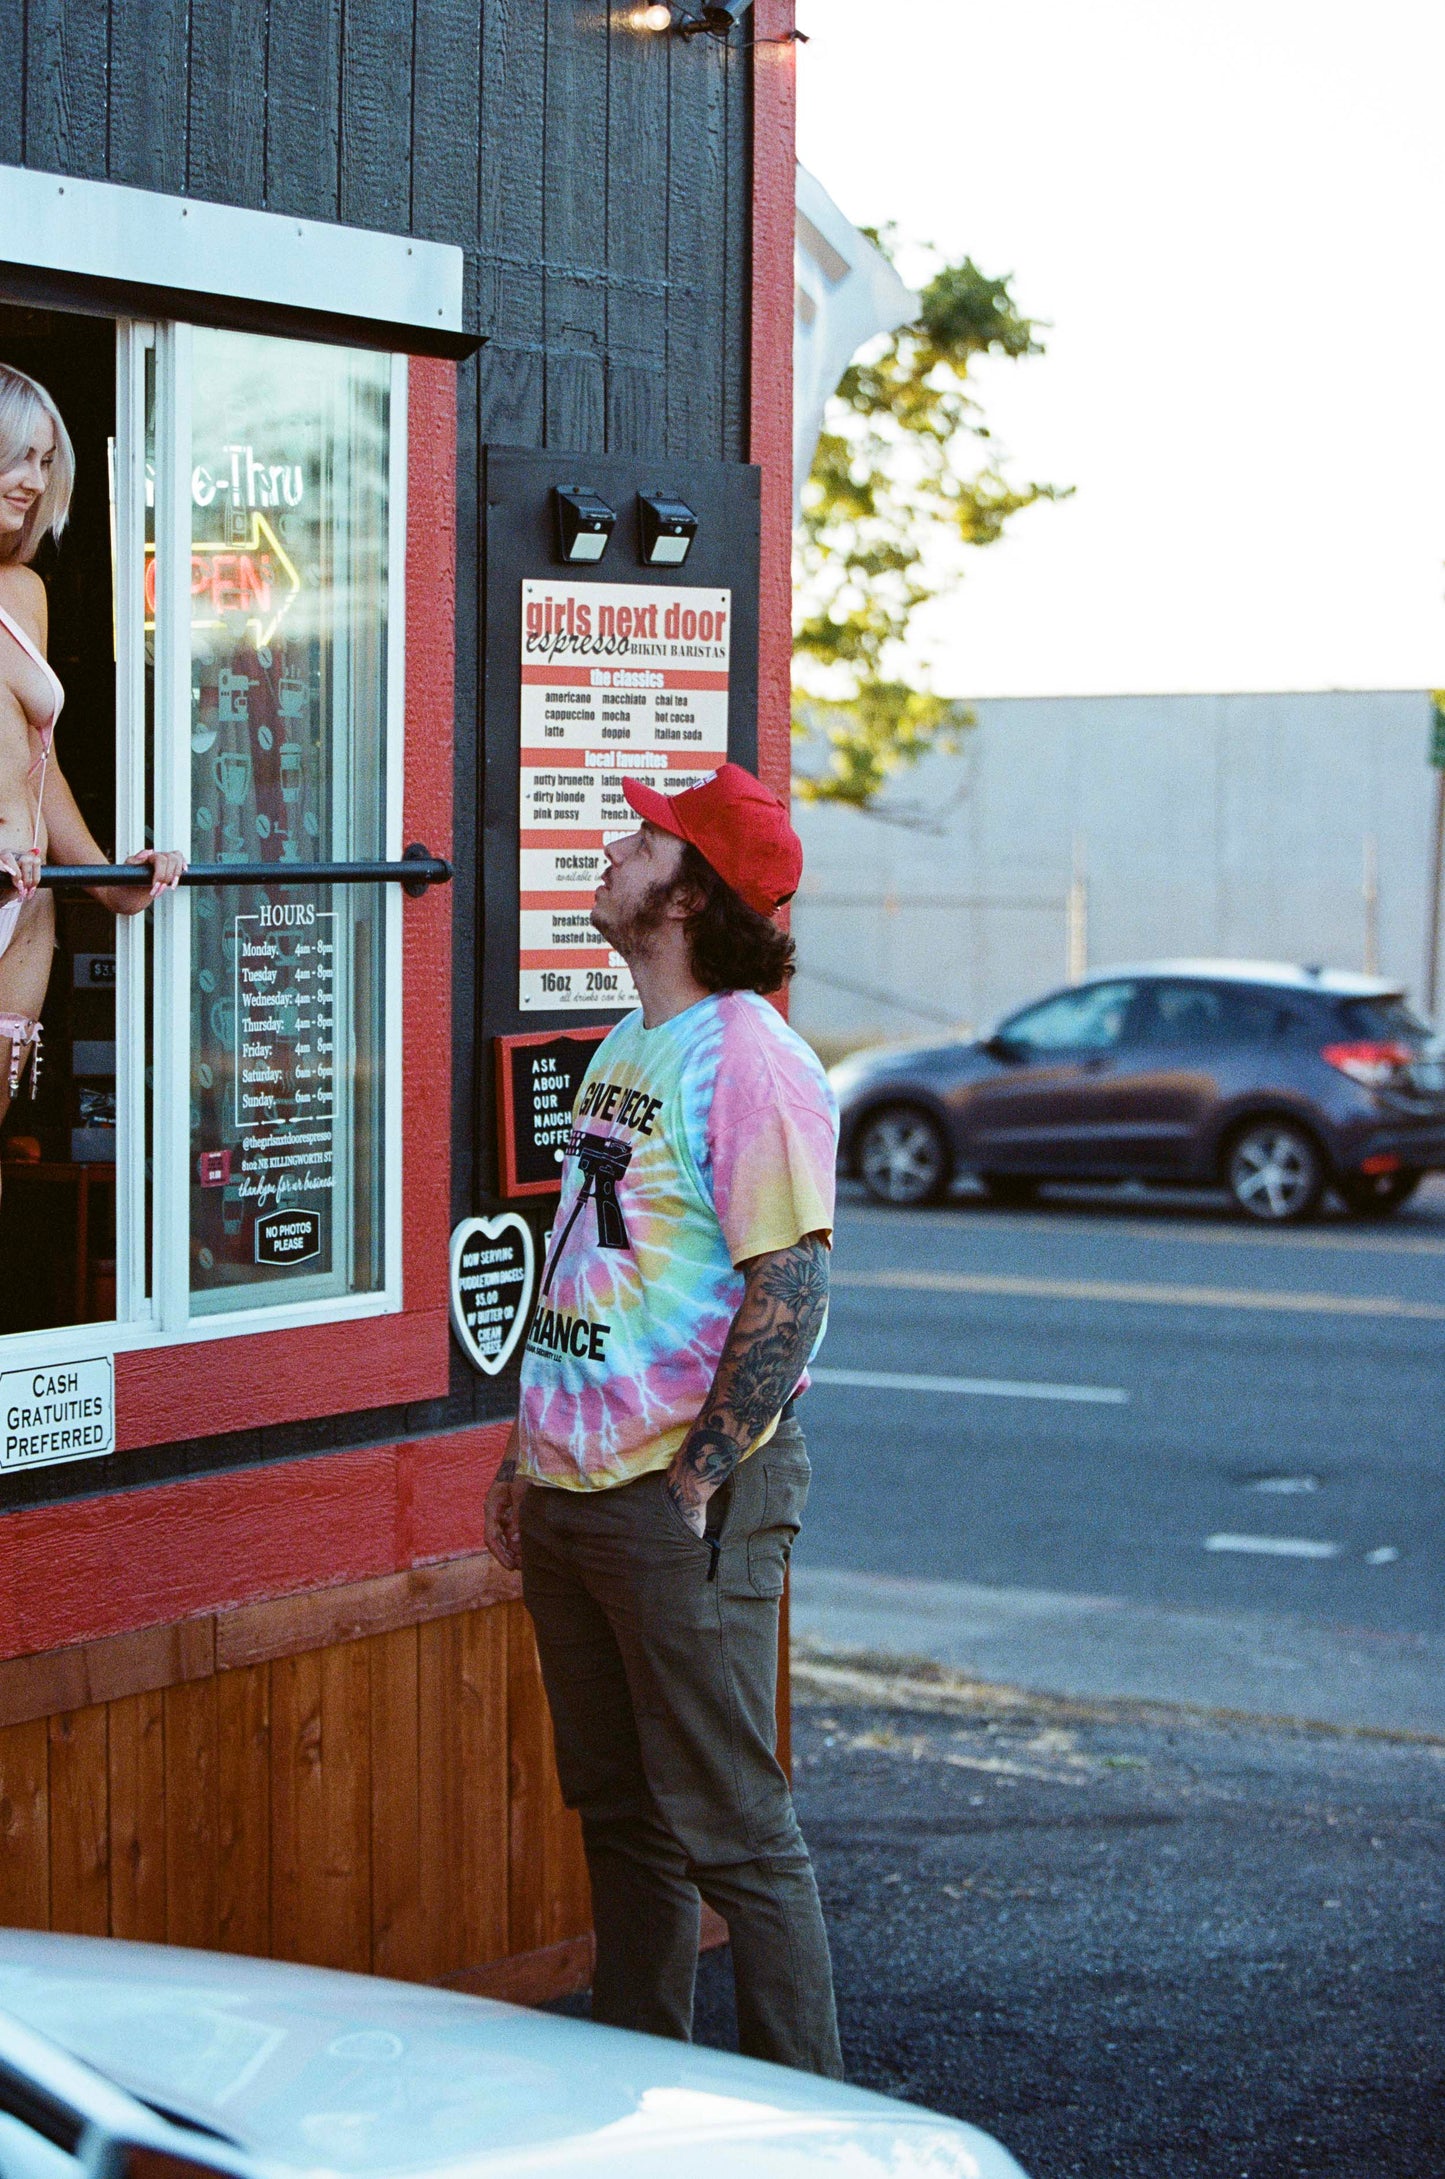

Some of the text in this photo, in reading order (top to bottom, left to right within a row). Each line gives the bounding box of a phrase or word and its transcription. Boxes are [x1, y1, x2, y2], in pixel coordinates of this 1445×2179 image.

[526, 596, 726, 642] girls next door
[526, 628, 726, 663] espresso BIKINI BARISTAS
[590, 669, 664, 688] the classics
[545, 691, 592, 704] americano
[602, 693, 646, 706] macchiato
[655, 694, 688, 707] chai tea
[545, 708, 595, 721] cappuccino
[602, 710, 630, 722] mocha
[655, 711, 695, 724] hot cocoa
[545, 725, 564, 737] latte
[602, 727, 631, 740] doppio
[683, 729, 703, 741] soda
[585, 750, 668, 769] local favorites
[534, 774, 594, 787] nutty brunette
[533, 791, 585, 804] dirty blonde
[533, 808, 579, 821] pink pussy
[601, 809, 628, 820] french
[555, 855, 599, 869] rockstar
[260, 904, 315, 926] HOURS
[552, 915, 591, 927] breakfas
[552, 932, 584, 944] toasted
[295, 943, 311, 957] 4am
[295, 968, 311, 982] 4am
[541, 972, 571, 992] 16oz
[586, 971, 618, 991] 20oz
[295, 993, 311, 1007] 4am
[295, 1018, 311, 1032] 4am
[295, 1042, 311, 1056] 4am
[295, 1064, 311, 1079] 6am
[532, 1058, 557, 1074] ASK
[533, 1074, 570, 1092] ABOUT
[295, 1089, 311, 1103] 6am
[533, 1094, 558, 1110] OUR
[579, 1082, 622, 1122] GIVE
[534, 1111, 572, 1128] NAUGH
[534, 1128, 573, 1146] COFFE
[258, 1158, 269, 1169] NE
[269, 1153, 323, 1168] KILLINGWORTH
[324, 1151, 333, 1162] ST
[265, 1221, 312, 1239] NO PHOTOS
[273, 1237, 304, 1252] PLEASE
[463, 1247, 514, 1268] NOW SERVING
[477, 1307, 503, 1325] BUTTER
[504, 1305, 514, 1320] OR
[477, 1326, 502, 1343] CREAM
[528, 1305, 611, 1362] HANCE
[32, 1372, 78, 1398] CASH
[7, 1397, 102, 1430] GRATUITIES
[6, 1424, 103, 1459] PREFERRED
